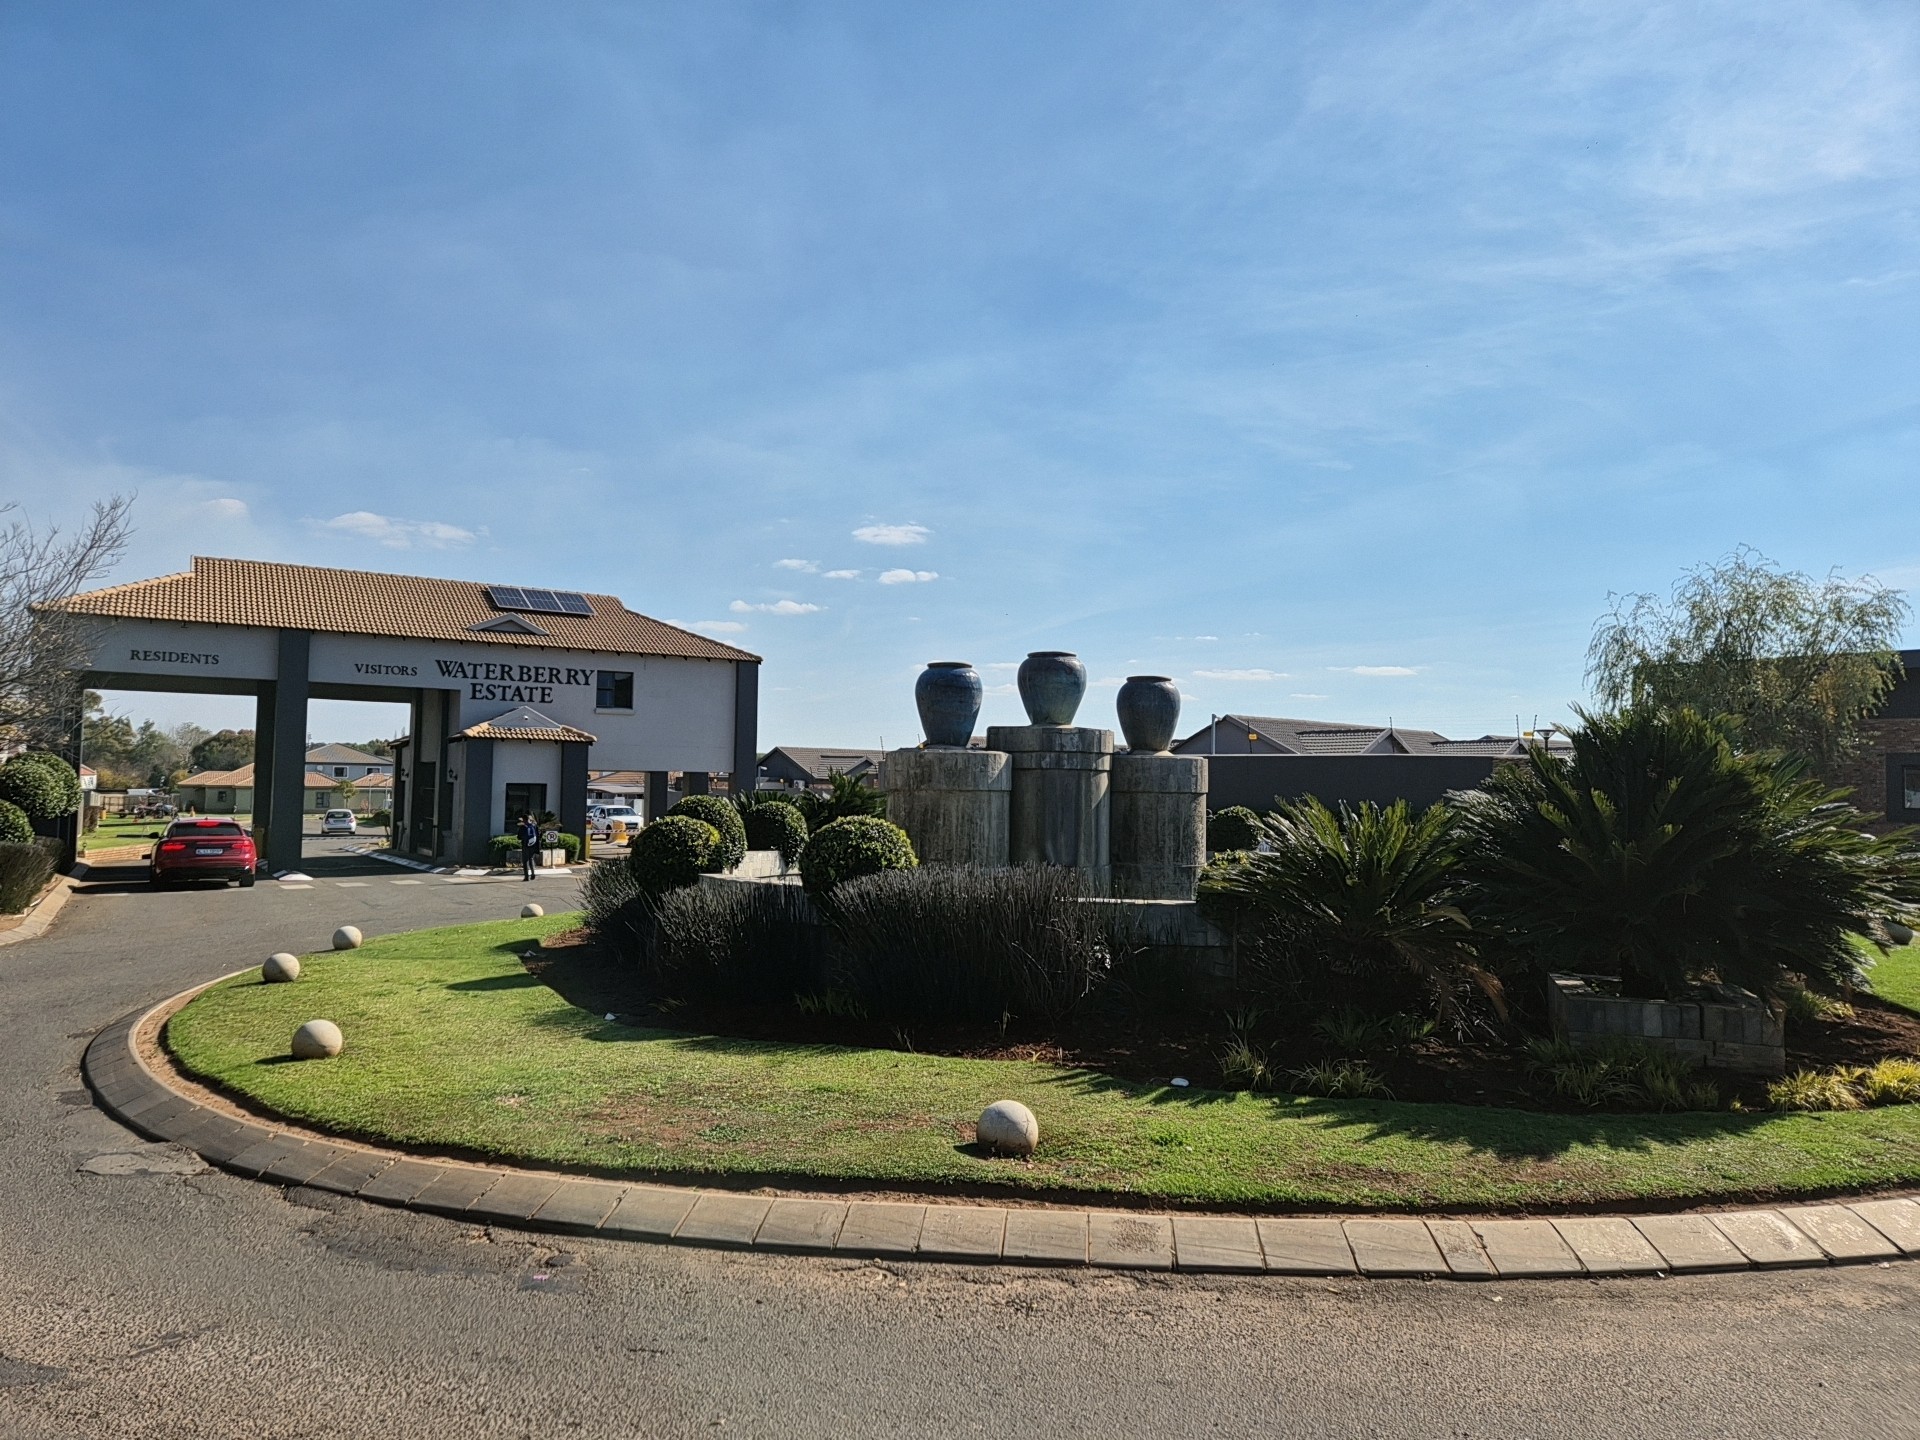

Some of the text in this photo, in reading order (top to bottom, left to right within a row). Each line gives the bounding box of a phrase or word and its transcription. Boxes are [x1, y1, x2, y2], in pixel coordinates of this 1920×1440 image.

[130, 649, 219, 666] RESIDENTS
[354, 662, 418, 677] VISITORS
[435, 659, 595, 686] WATERBERRY
[470, 682, 554, 704] ESTATE
